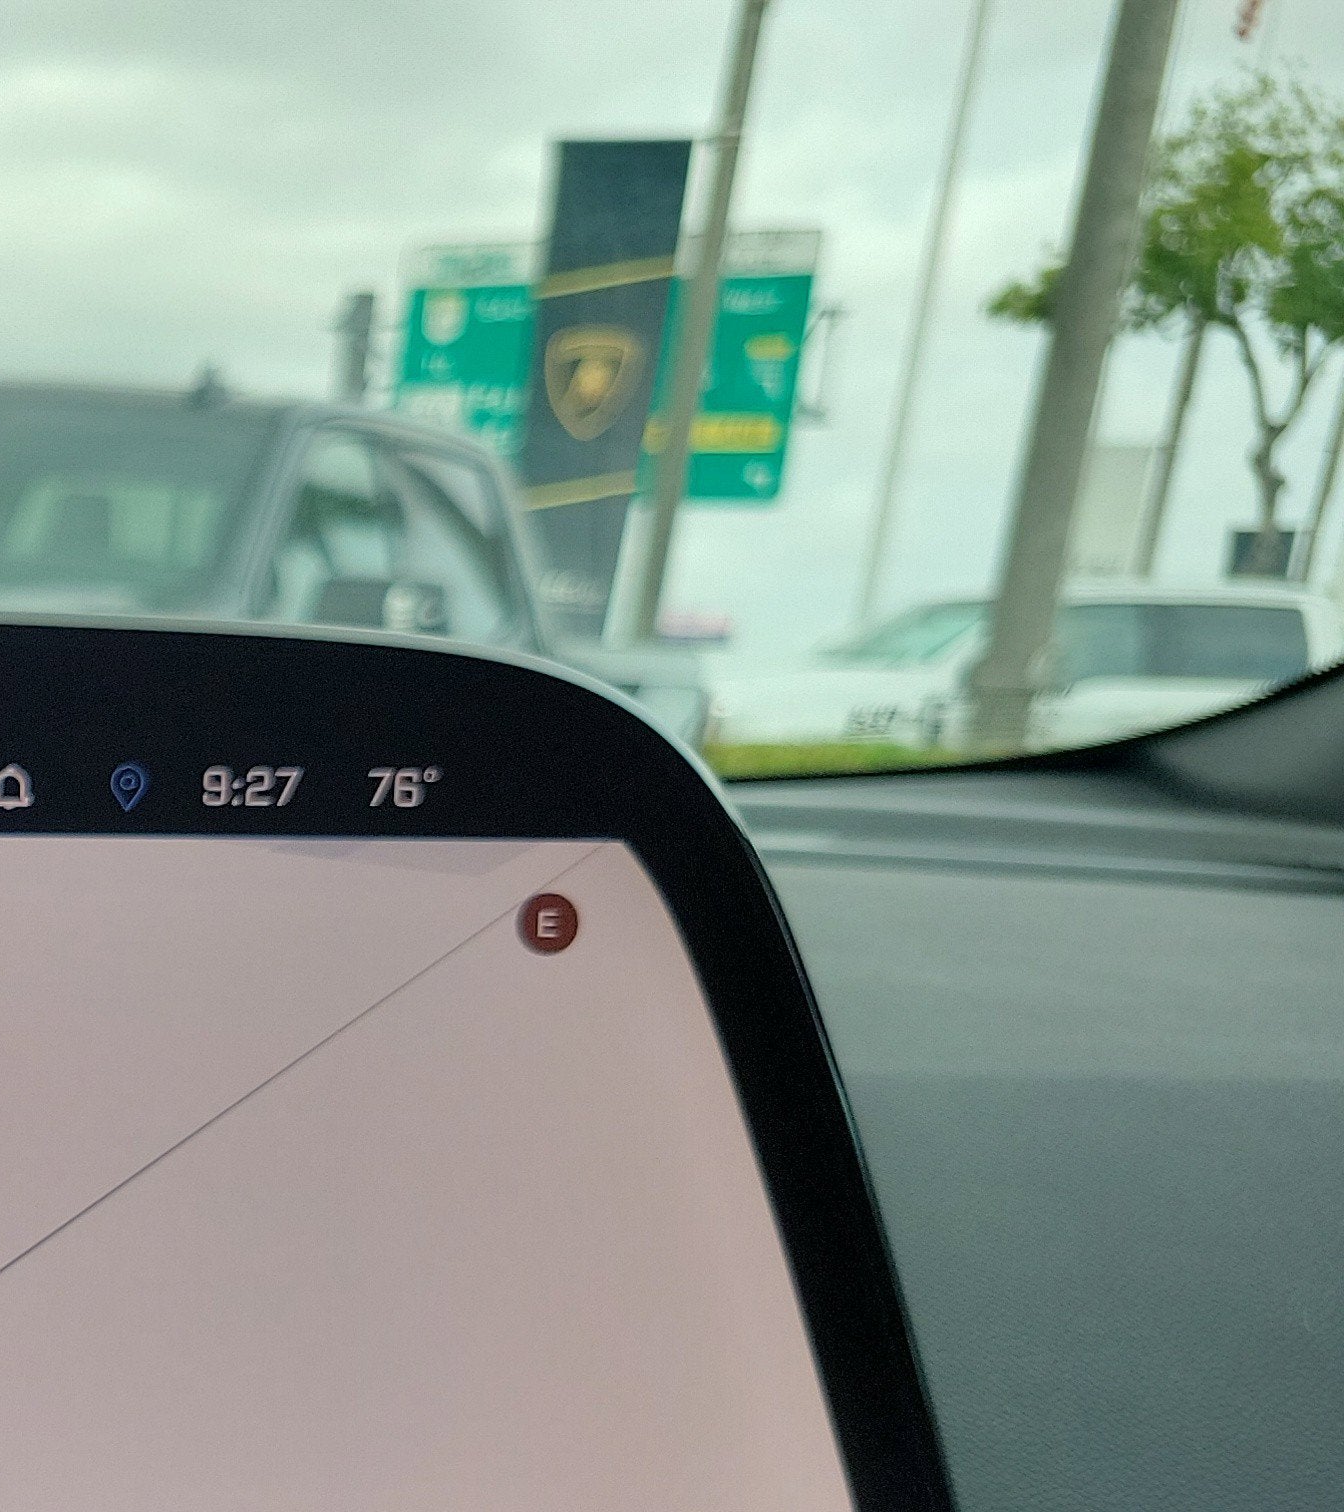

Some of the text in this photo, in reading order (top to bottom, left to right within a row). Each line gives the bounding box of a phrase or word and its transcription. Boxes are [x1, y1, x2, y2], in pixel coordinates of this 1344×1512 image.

[200, 764, 446, 808] 9:27 76°
[535, 910, 560, 939] E
